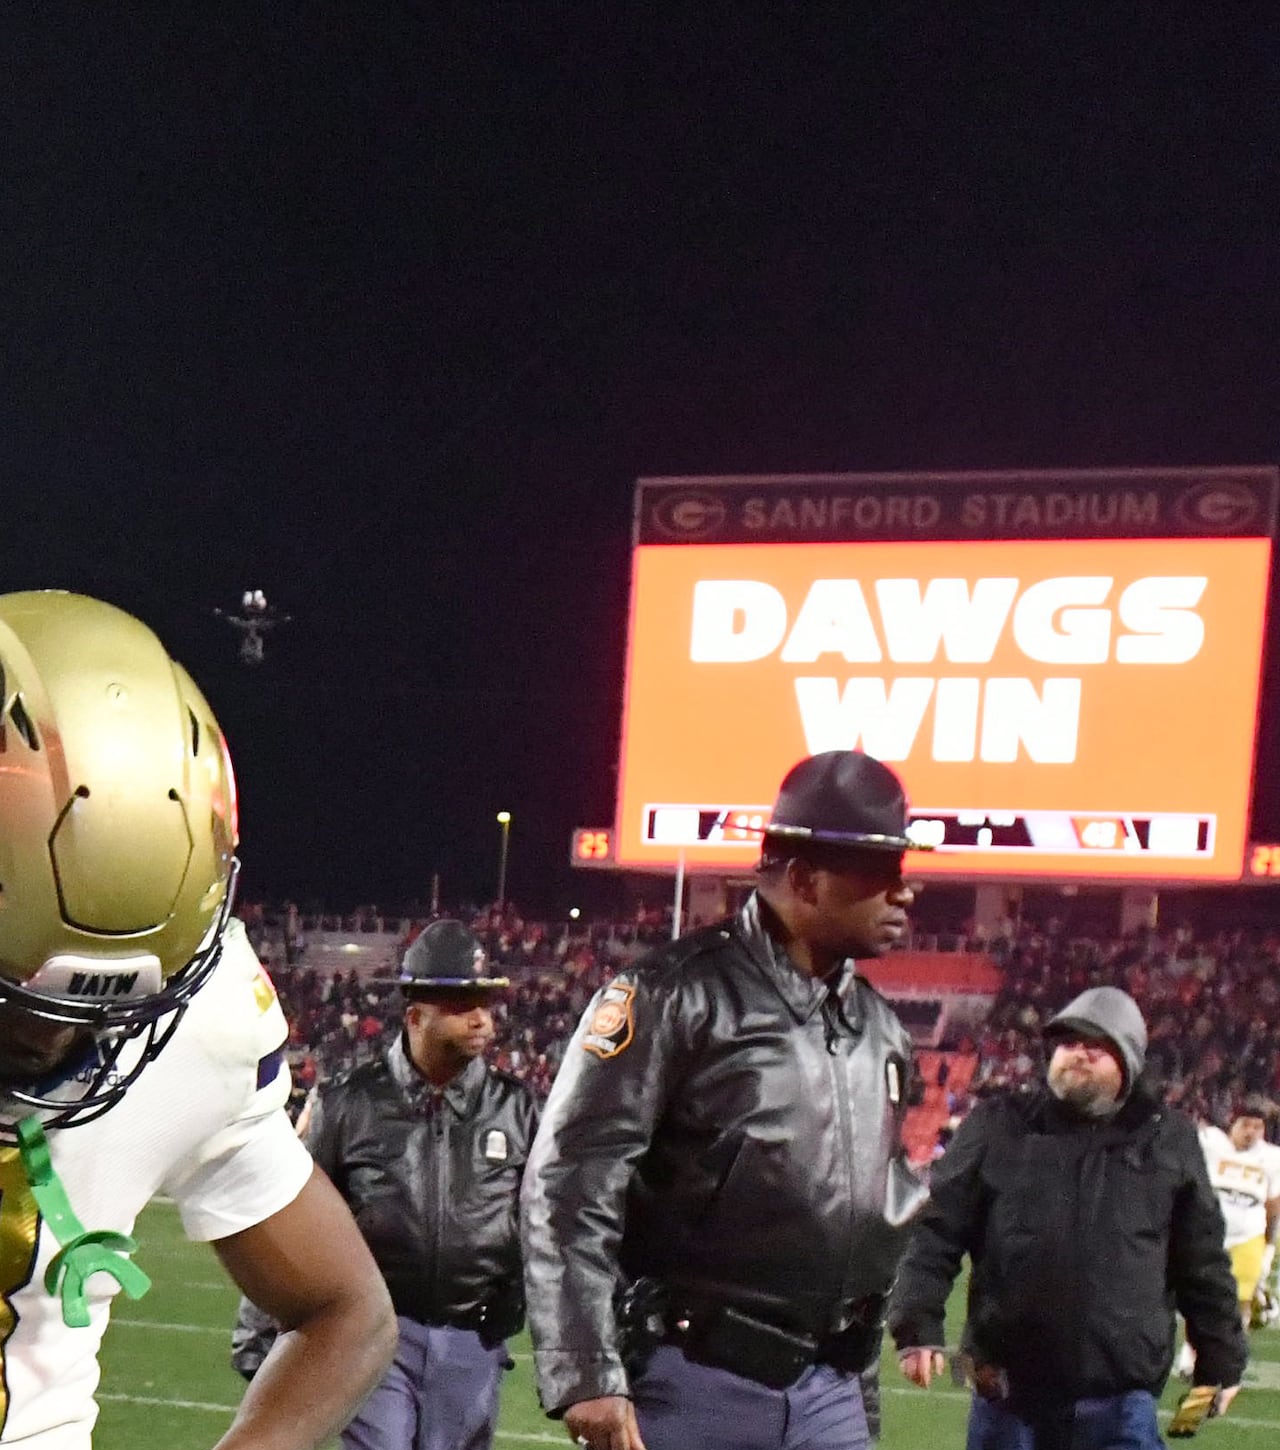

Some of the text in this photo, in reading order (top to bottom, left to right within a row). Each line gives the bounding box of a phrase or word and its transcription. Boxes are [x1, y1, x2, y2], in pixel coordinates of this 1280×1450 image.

[743, 491, 1159, 529] SANFORD STADIUM
[689, 575, 1208, 665] DAWGS
[794, 676, 1082, 763] WIN
[577, 831, 609, 860] 25
